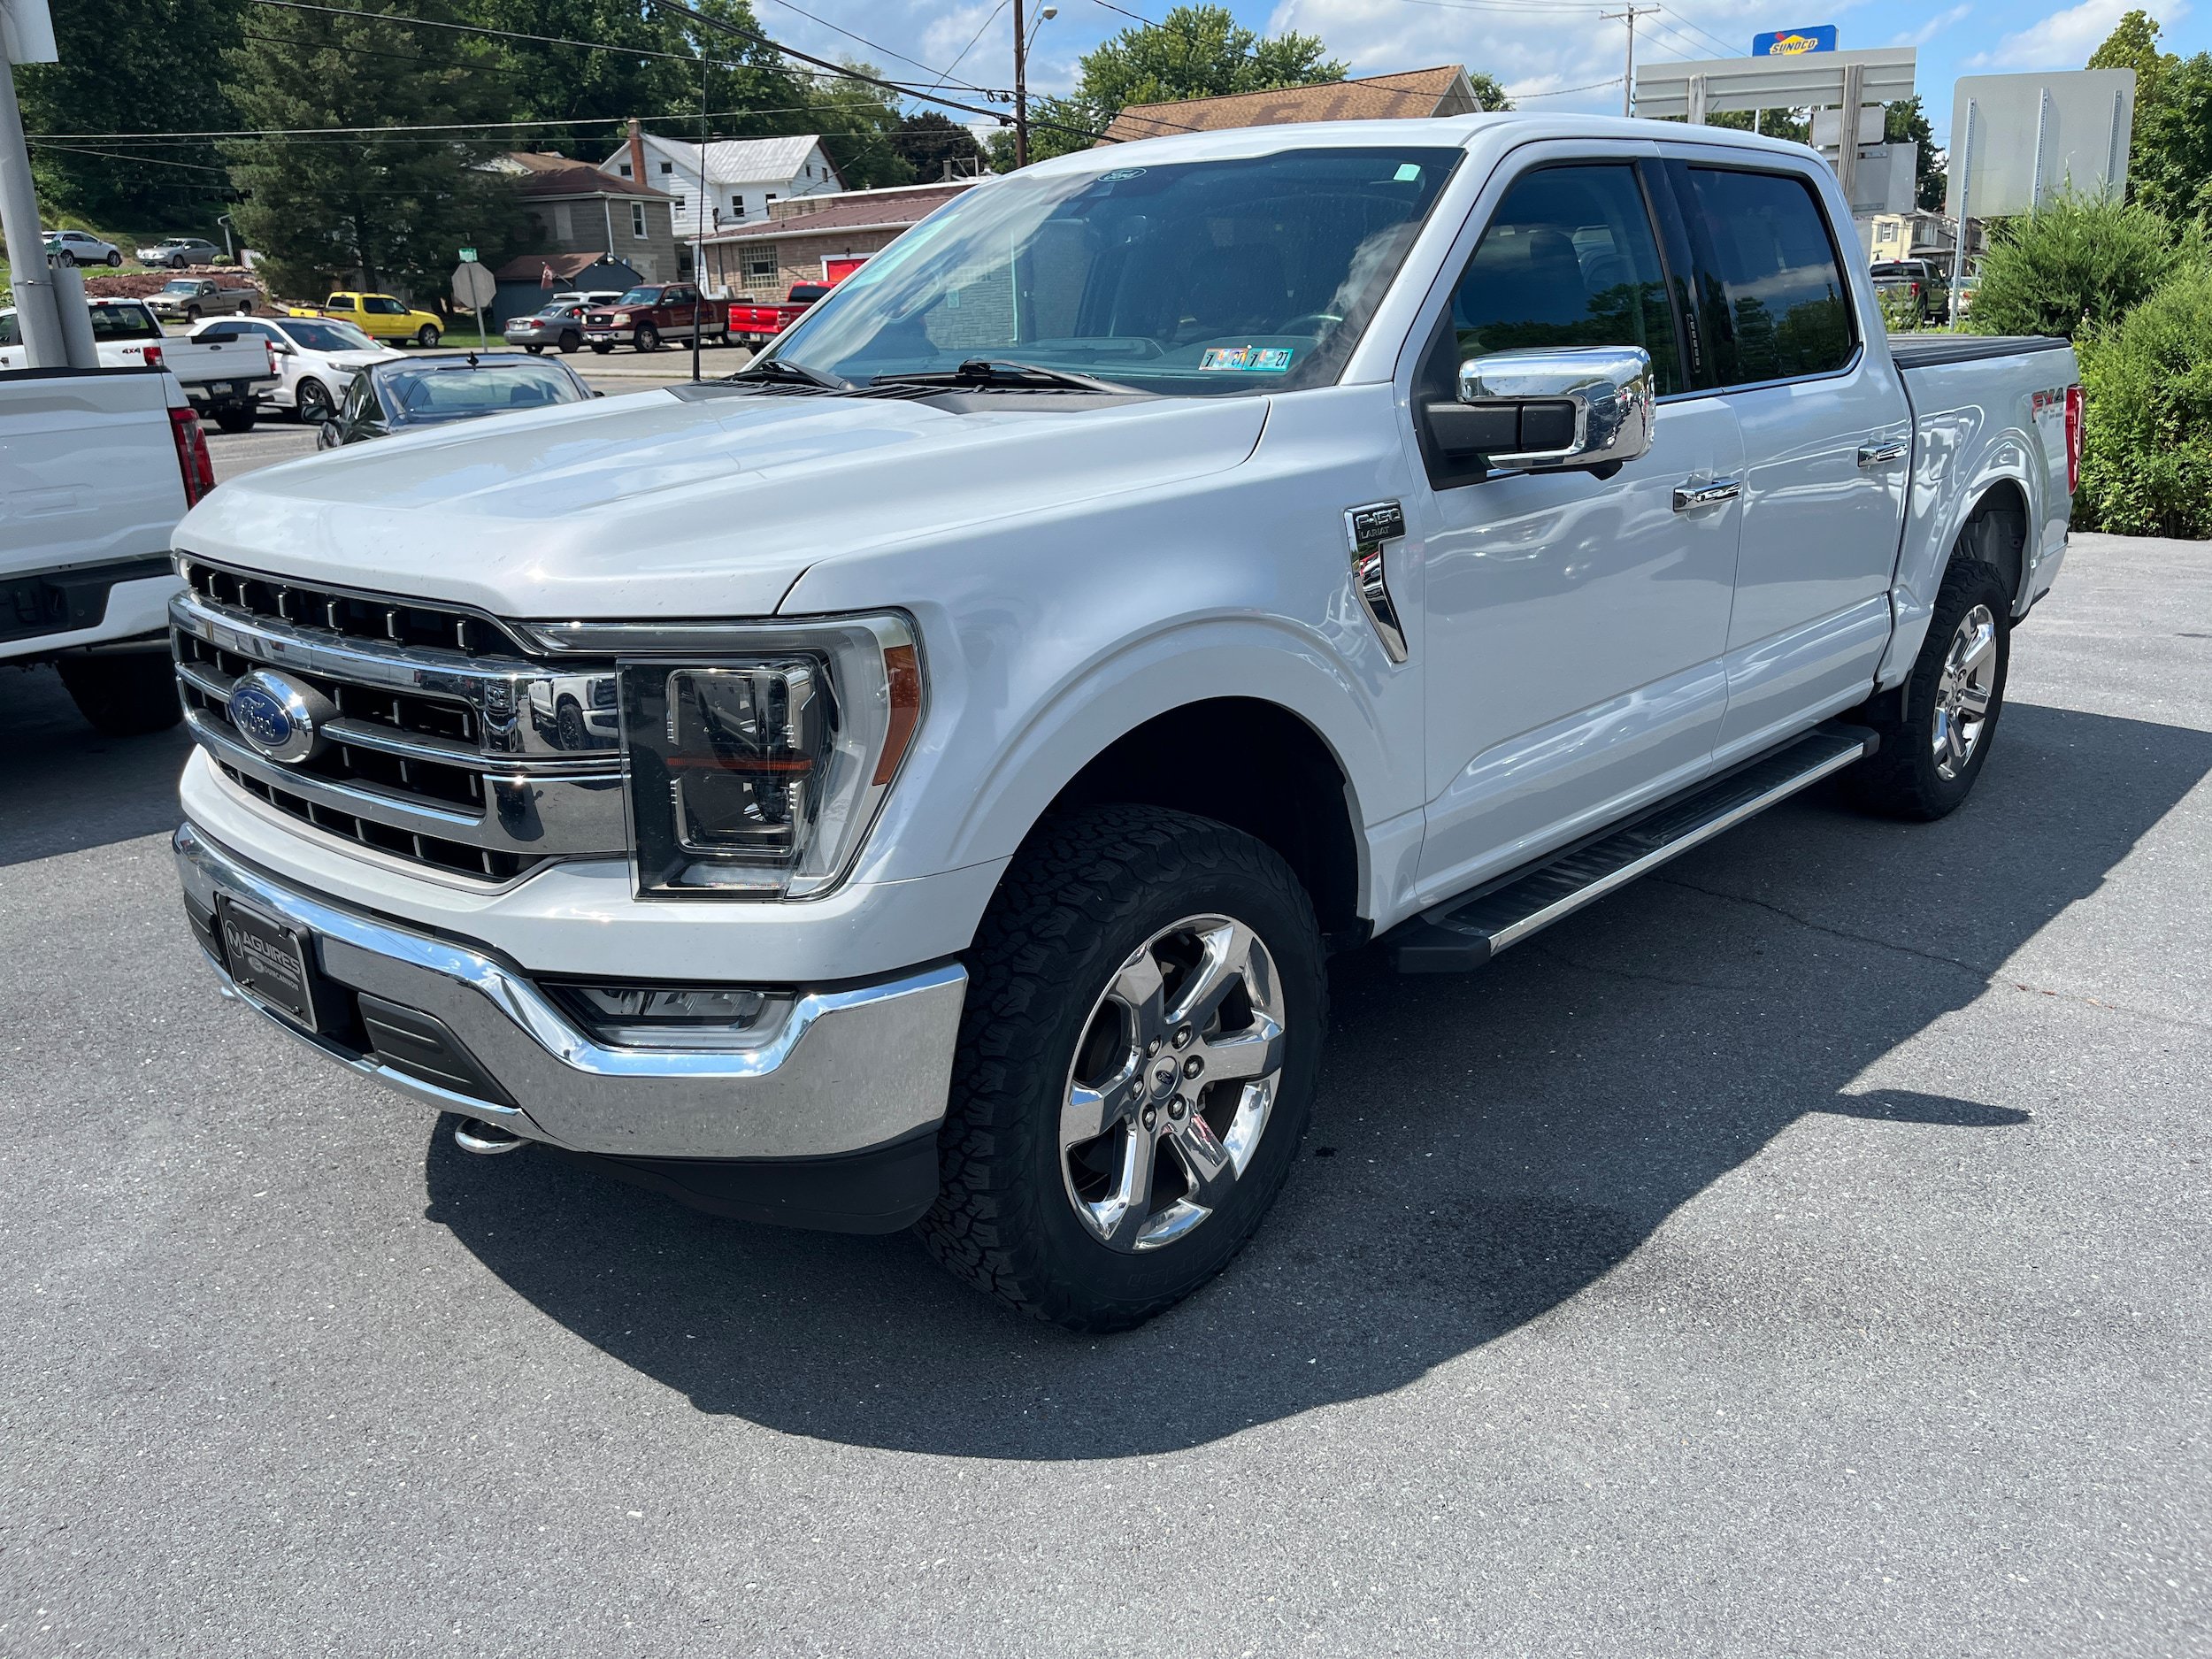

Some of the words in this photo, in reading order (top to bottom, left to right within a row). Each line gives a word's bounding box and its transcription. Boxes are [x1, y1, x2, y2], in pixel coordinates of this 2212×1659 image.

[1771, 39, 1816, 53] SUNOCO
[1248, 353, 1258, 367] 7
[1275, 351, 1289, 367] 27
[1356, 508, 1402, 530] F-150
[1360, 526, 1390, 540] LARIAT
[240, 696, 276, 739] Ford
